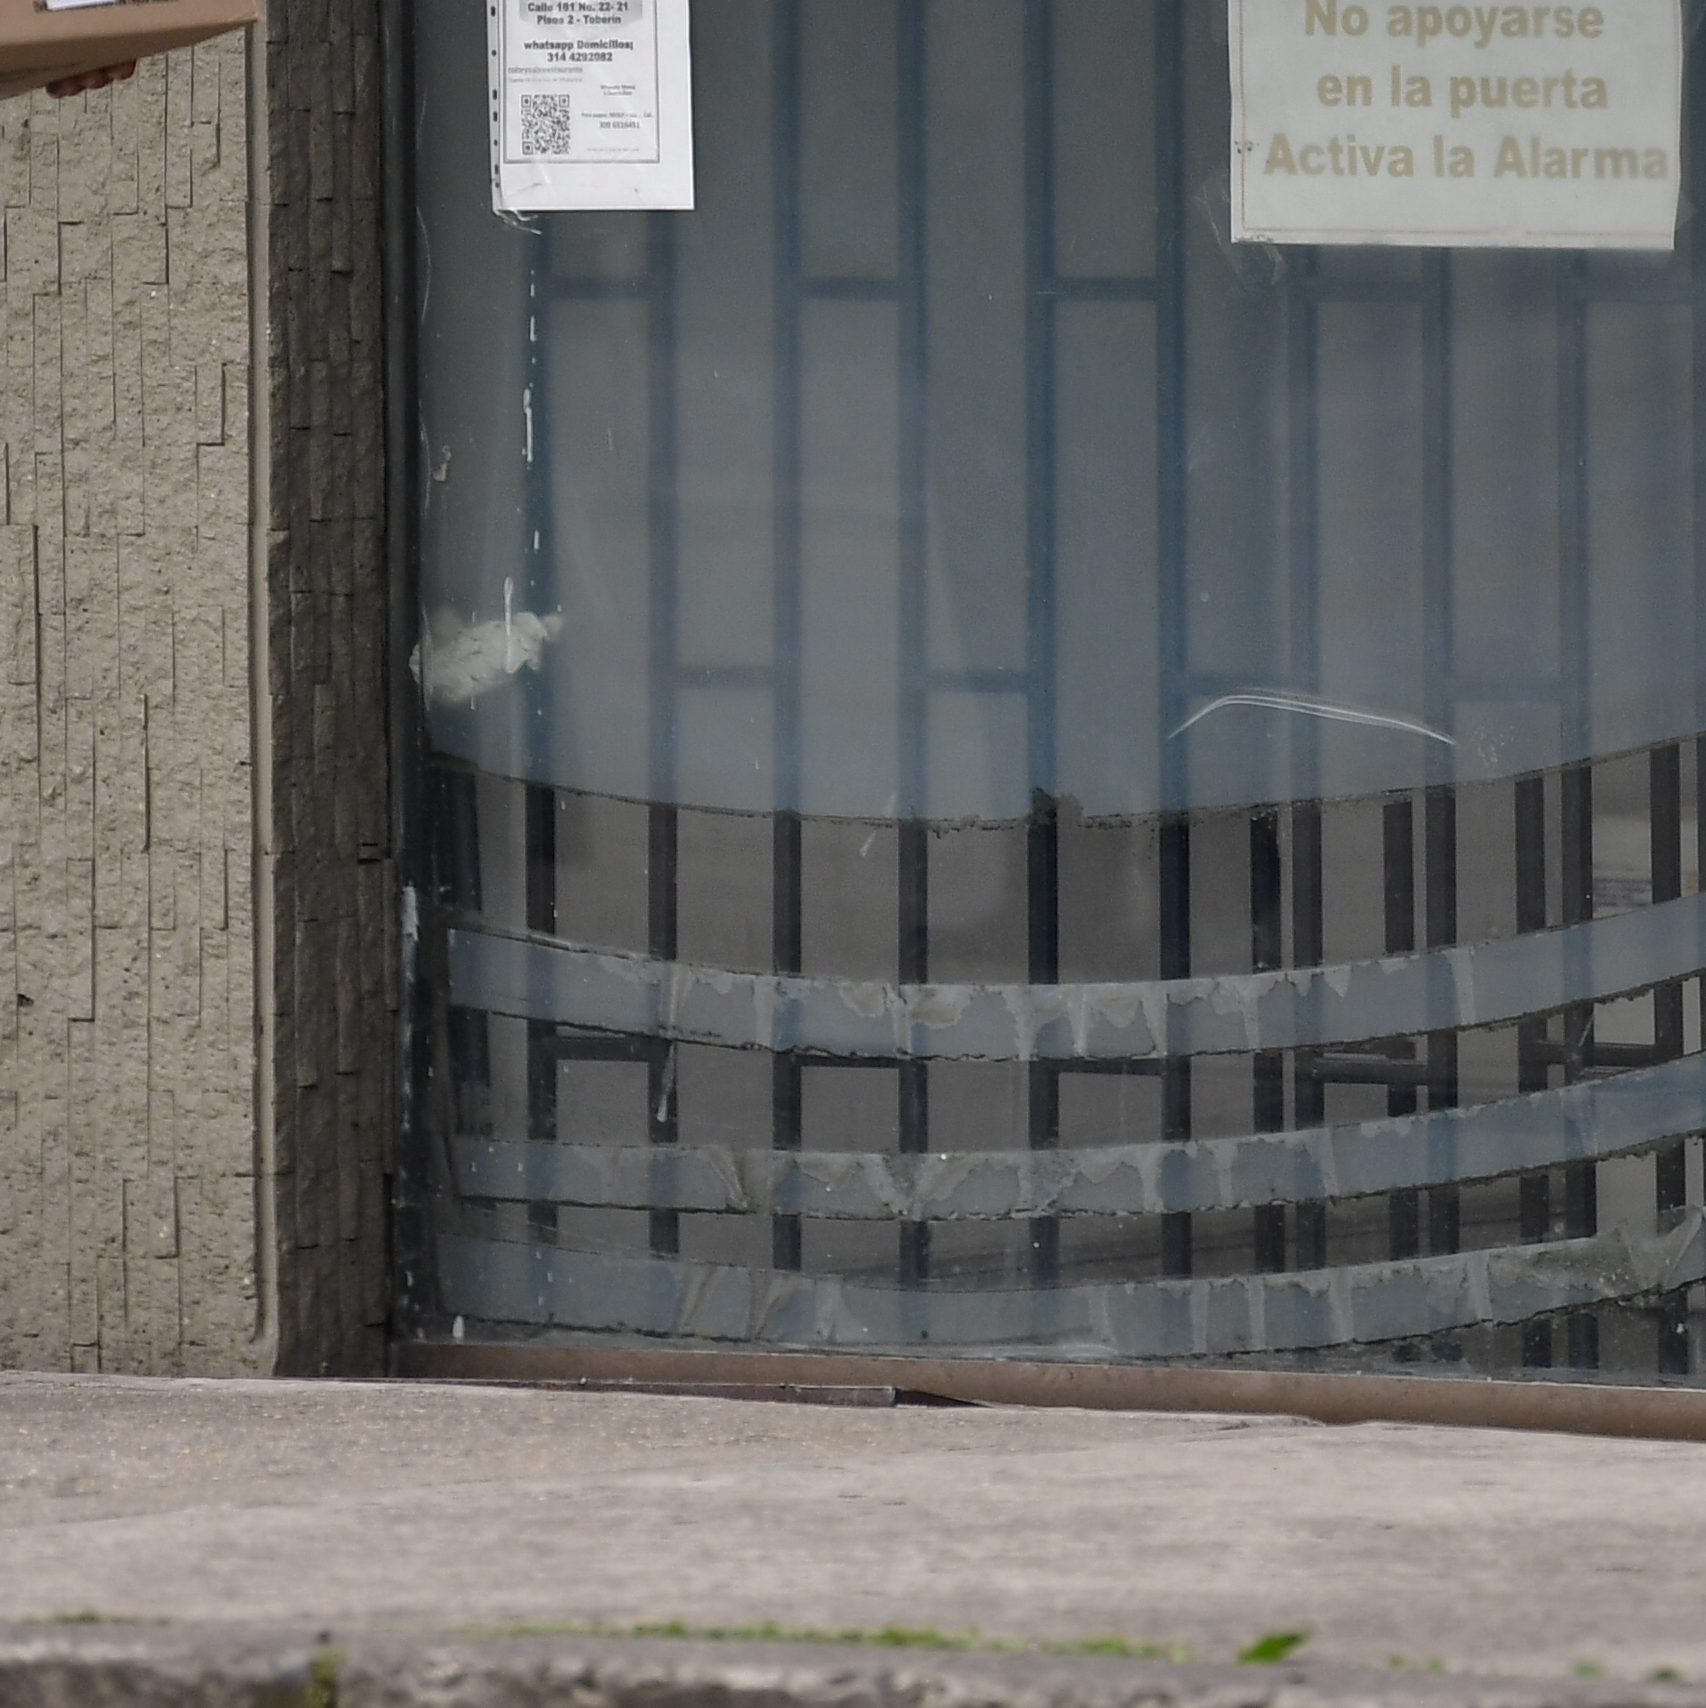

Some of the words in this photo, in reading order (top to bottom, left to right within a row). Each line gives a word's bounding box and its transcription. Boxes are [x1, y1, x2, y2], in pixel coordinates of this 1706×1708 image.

[1386, 3, 1605, 49] apoyarse
[547, 52, 566, 62] 314
[1317, 73, 1373, 107] en
[1391, 65, 1432, 108] la
[1450, 68, 1608, 118] puerta
[1263, 133, 1415, 178] Activa
[1434, 135, 1475, 178] la
[1493, 135, 1669, 180] Alarma
